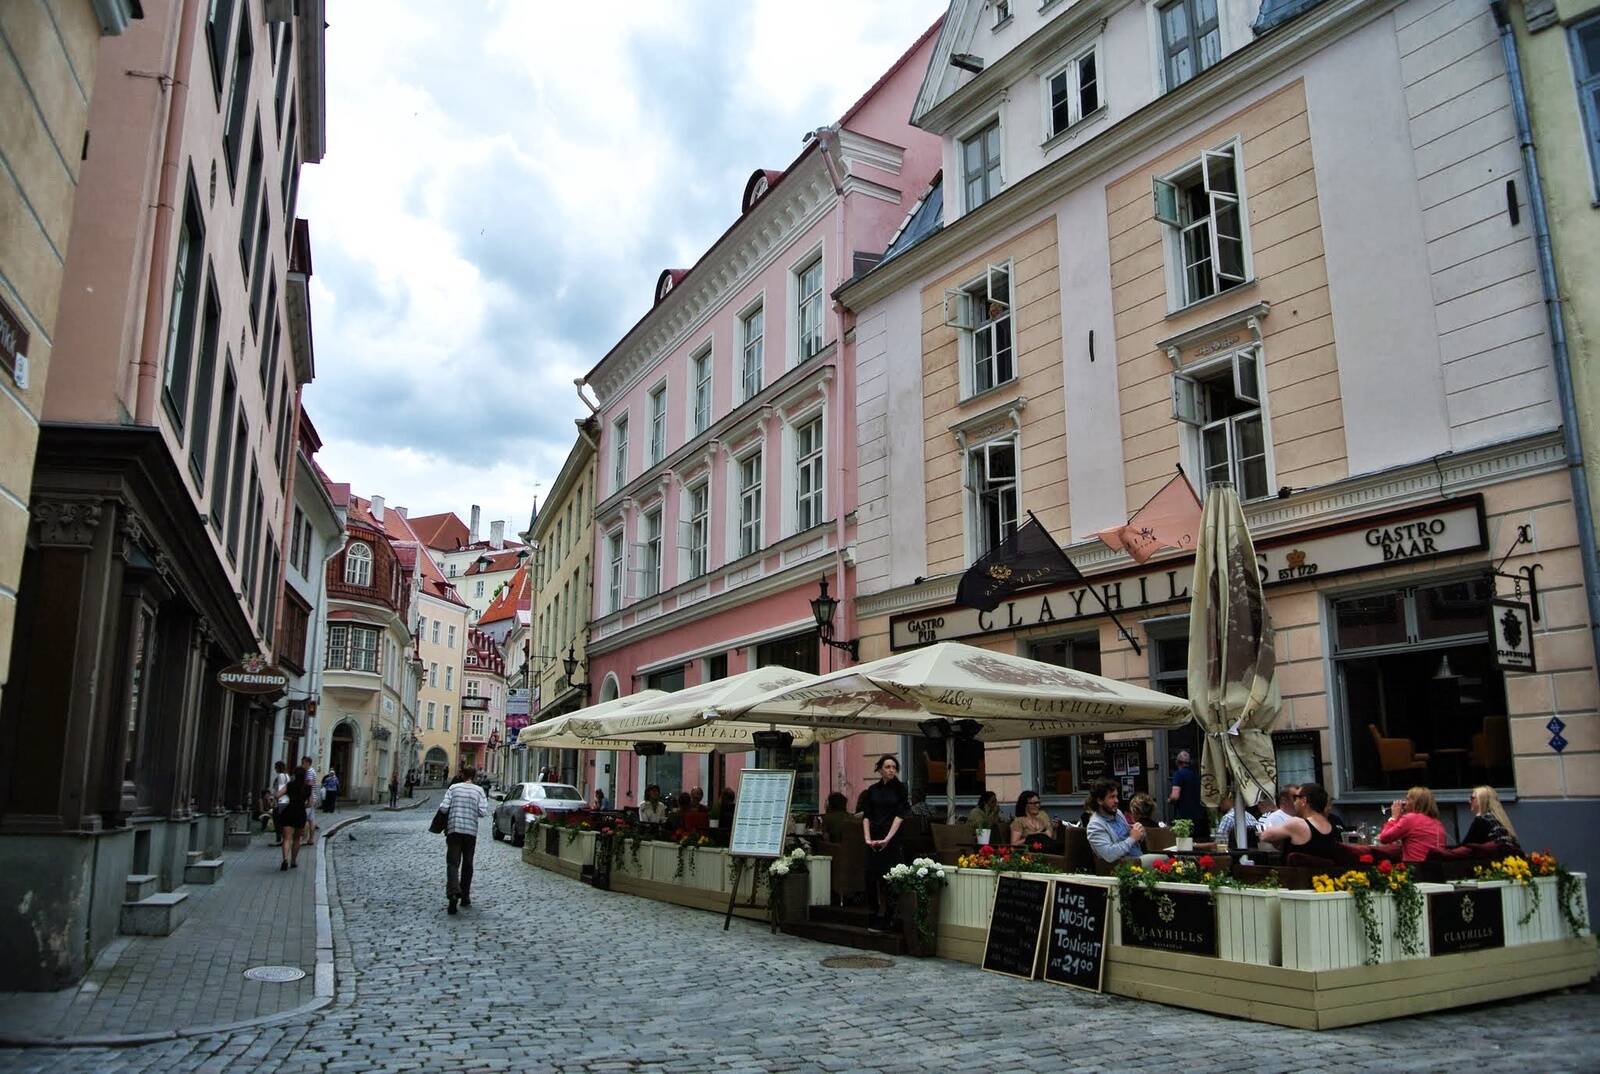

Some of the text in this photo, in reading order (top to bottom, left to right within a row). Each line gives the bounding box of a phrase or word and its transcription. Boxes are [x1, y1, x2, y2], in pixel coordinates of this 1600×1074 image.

[1365, 518, 1446, 547] GASTRO
[1382, 537, 1439, 561] BAAR
[1278, 563, 1318, 580] EST 1729
[978, 553, 1269, 632] CLAYHILS
[907, 617, 945, 633] GASTRO
[918, 629, 937, 642] PUB
[220, 673, 286, 685] SUVENIIRID
[1019, 700, 1128, 716] CLAYHILLS
[619, 713, 671, 729] CLAYHILLS
[1051, 958, 1062, 967] AT
